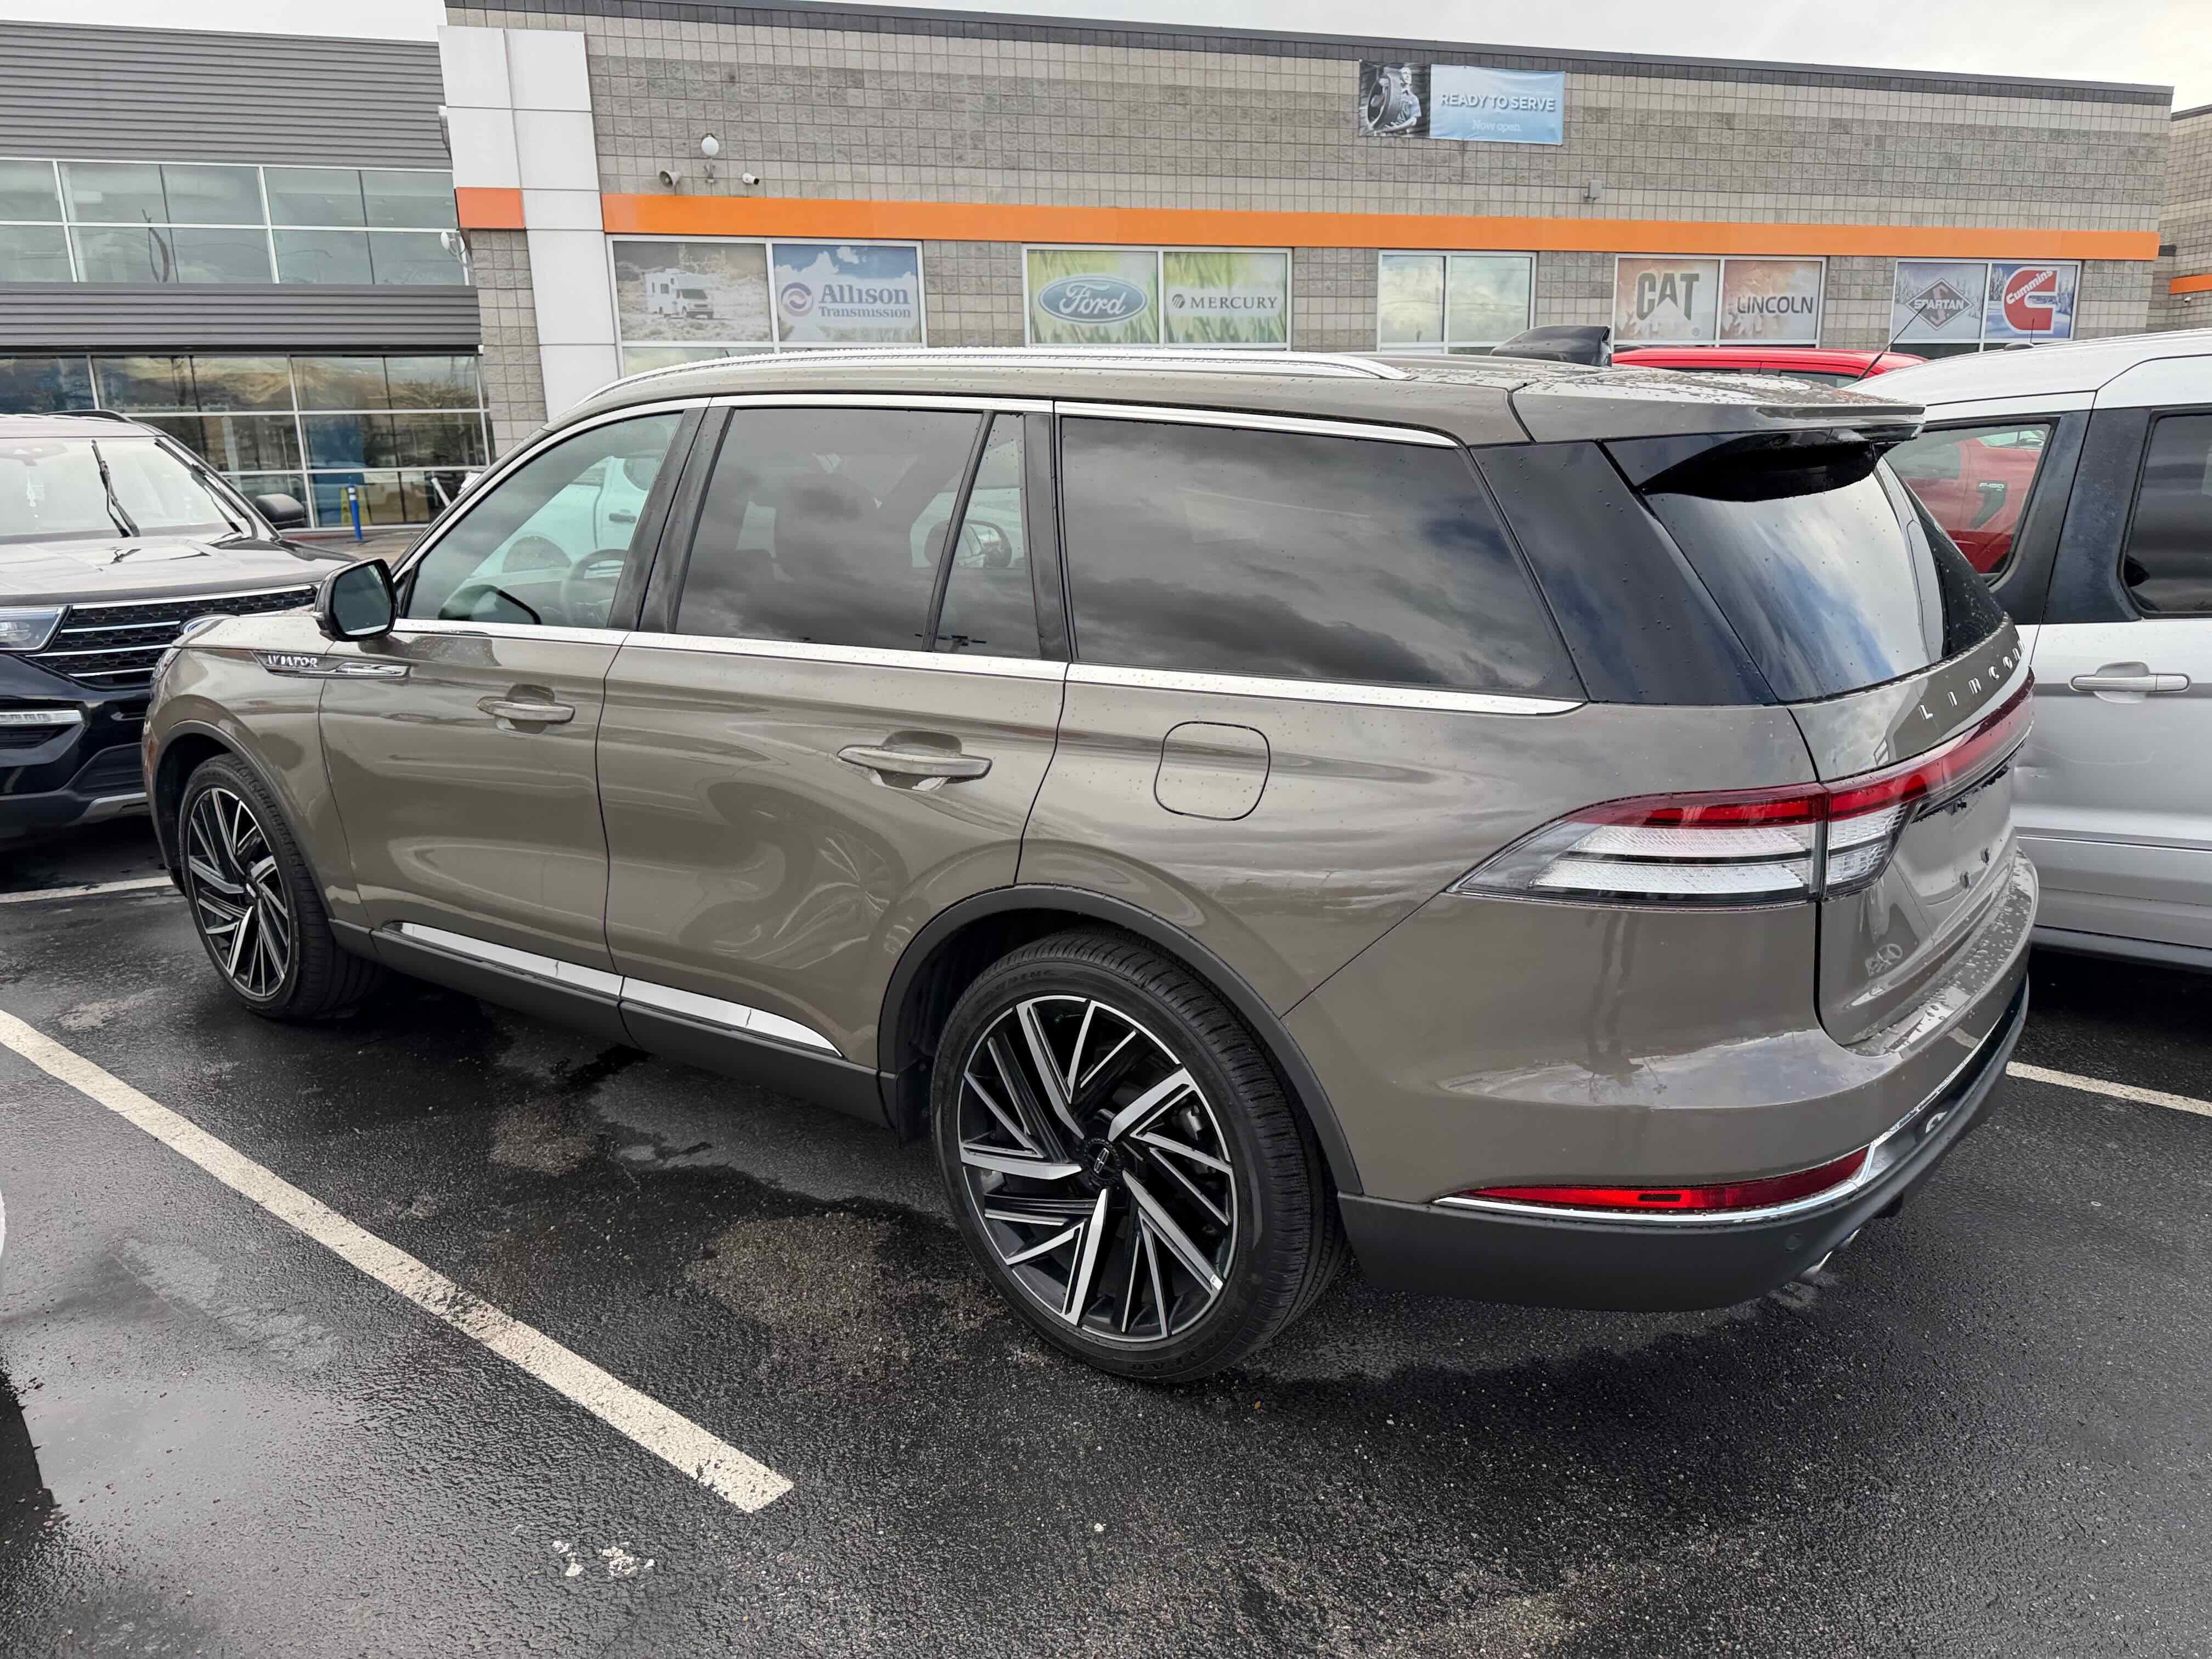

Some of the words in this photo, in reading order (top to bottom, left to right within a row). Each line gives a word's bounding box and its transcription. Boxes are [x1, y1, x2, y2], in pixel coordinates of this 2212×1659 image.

[1440, 93, 1487, 108] READY
[1490, 94, 1509, 110] TO
[1510, 96, 1556, 112] SERVE
[1472, 119, 1496, 131] Now
[819, 283, 910, 304] Allison
[2006, 269, 2053, 305] Cummins
[1059, 284, 1126, 315] Ford
[1189, 296, 1277, 310] MERCURY
[1637, 273, 1700, 321] CAT
[1737, 295, 1813, 315] LINCOLN
[1914, 298, 1965, 310] SPARTAN
[819, 305, 911, 318] Transmission
